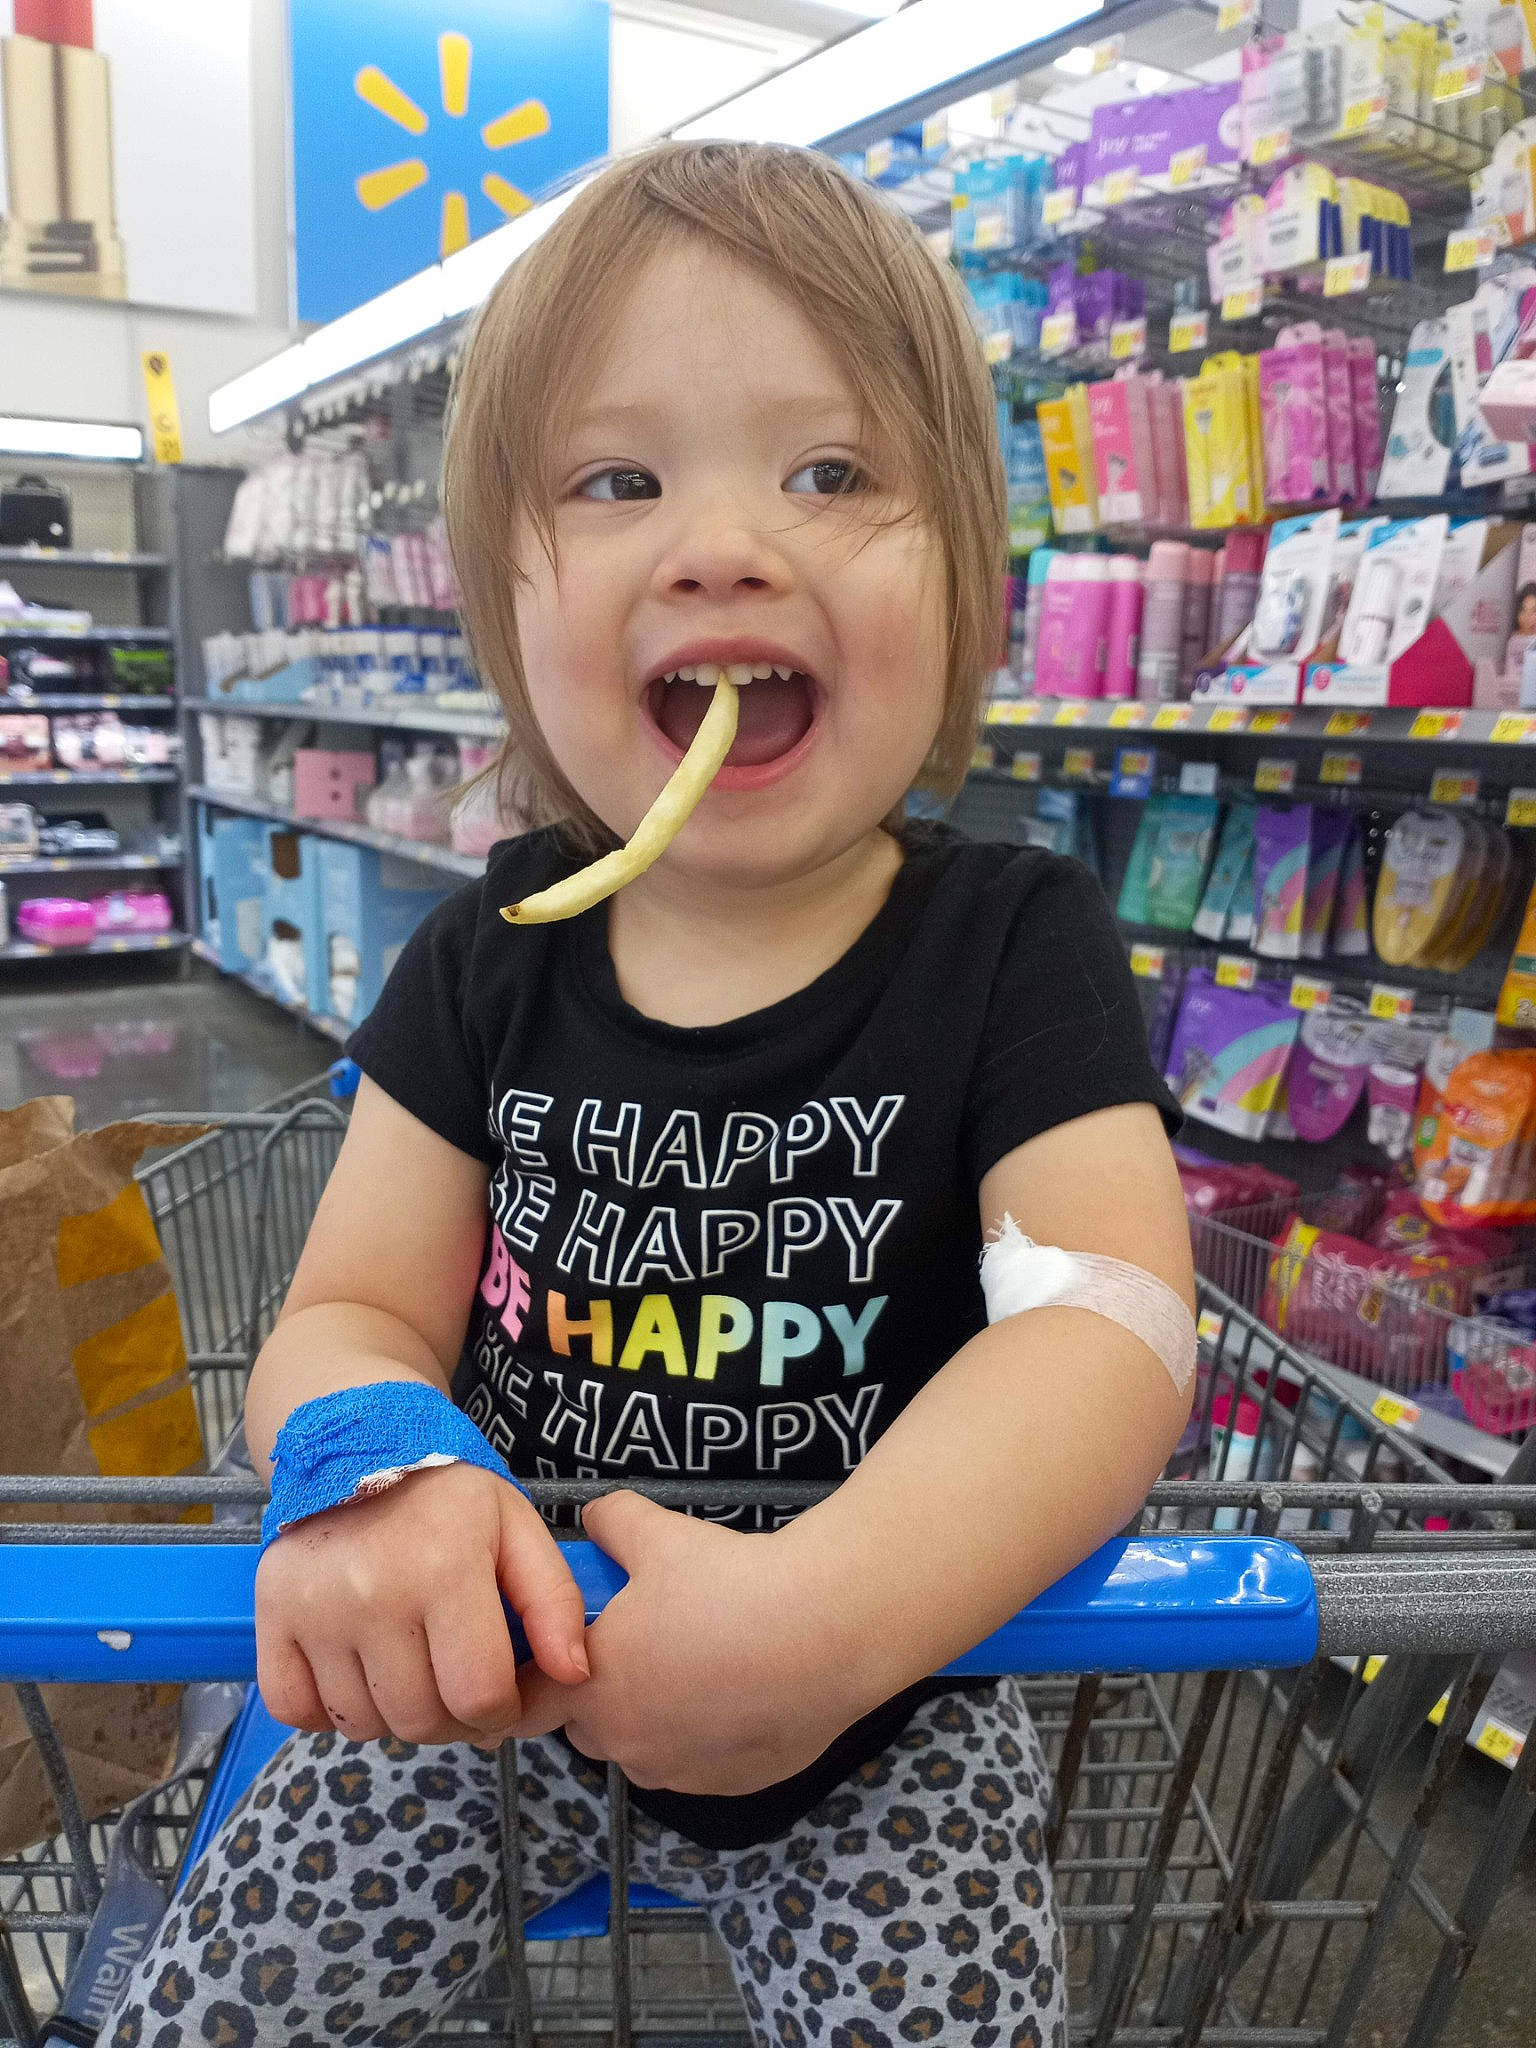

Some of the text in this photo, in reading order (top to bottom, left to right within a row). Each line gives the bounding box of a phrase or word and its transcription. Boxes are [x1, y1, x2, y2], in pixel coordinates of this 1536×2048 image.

[573, 1095, 906, 1188] HAPPY
[557, 1188, 903, 1287] HAPPY
[480, 1223, 889, 1386] BE HAPPY
[543, 1369, 884, 1471] HAPPY
